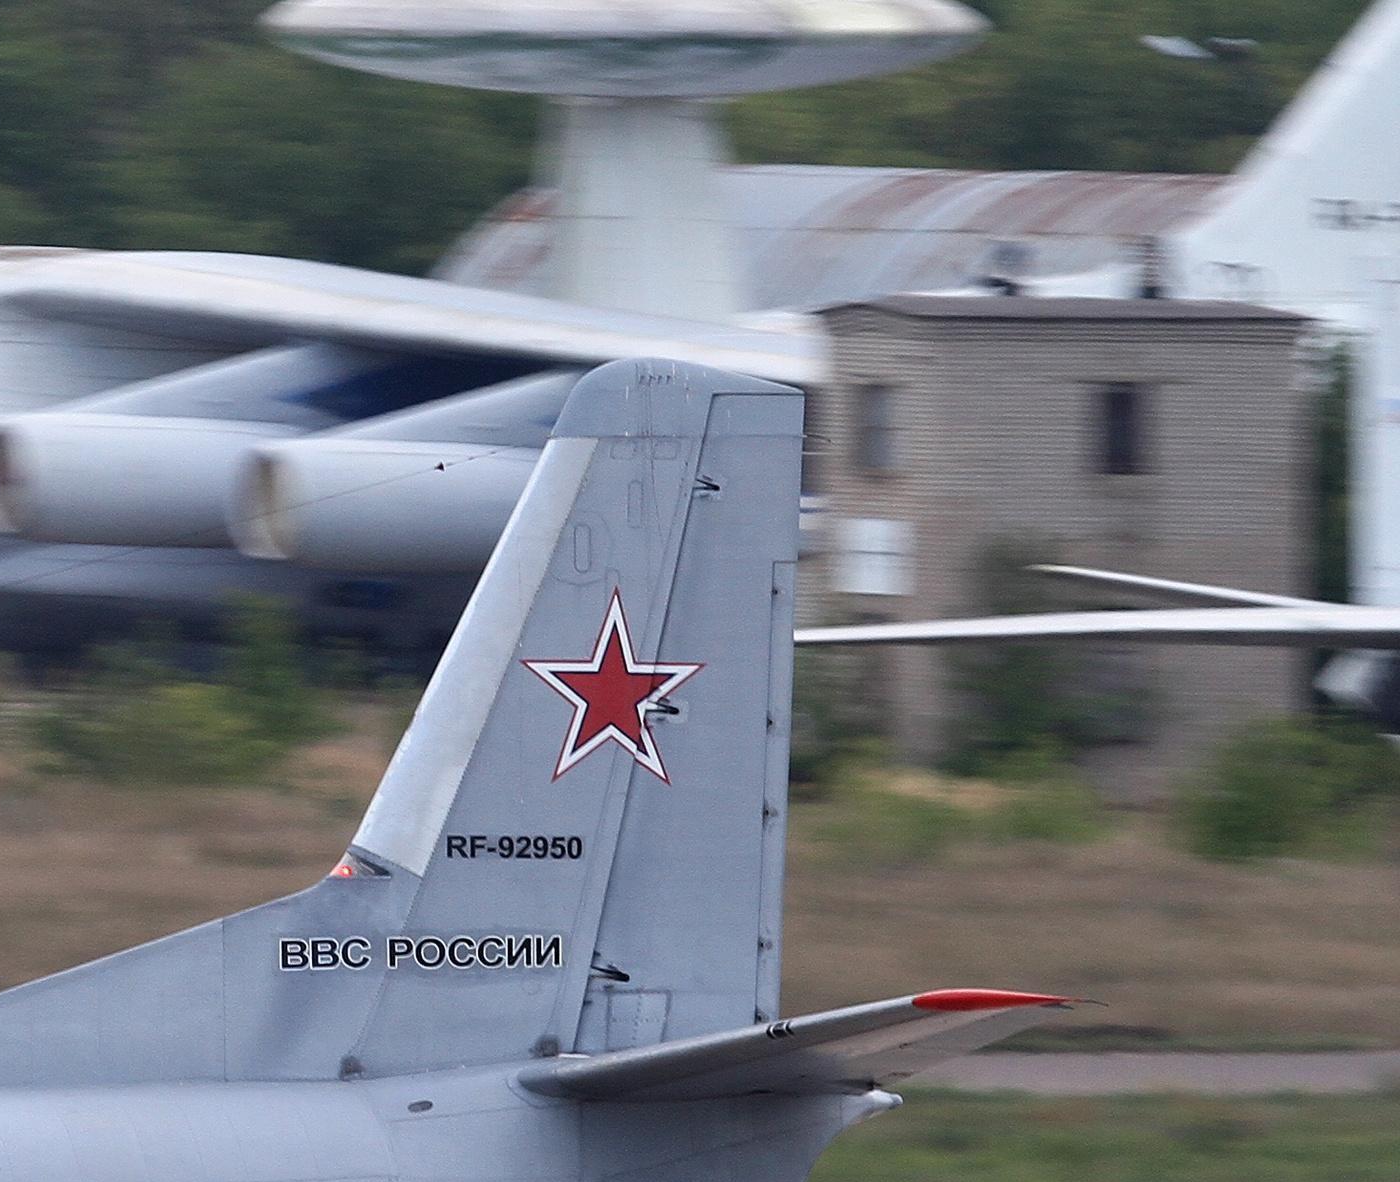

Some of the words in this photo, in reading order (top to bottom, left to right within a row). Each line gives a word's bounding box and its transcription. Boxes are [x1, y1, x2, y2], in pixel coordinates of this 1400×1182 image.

[446, 835, 583, 860] RF-92950
[279, 936, 371, 971] ВВС
[387, 934, 563, 969] РОССИИ
